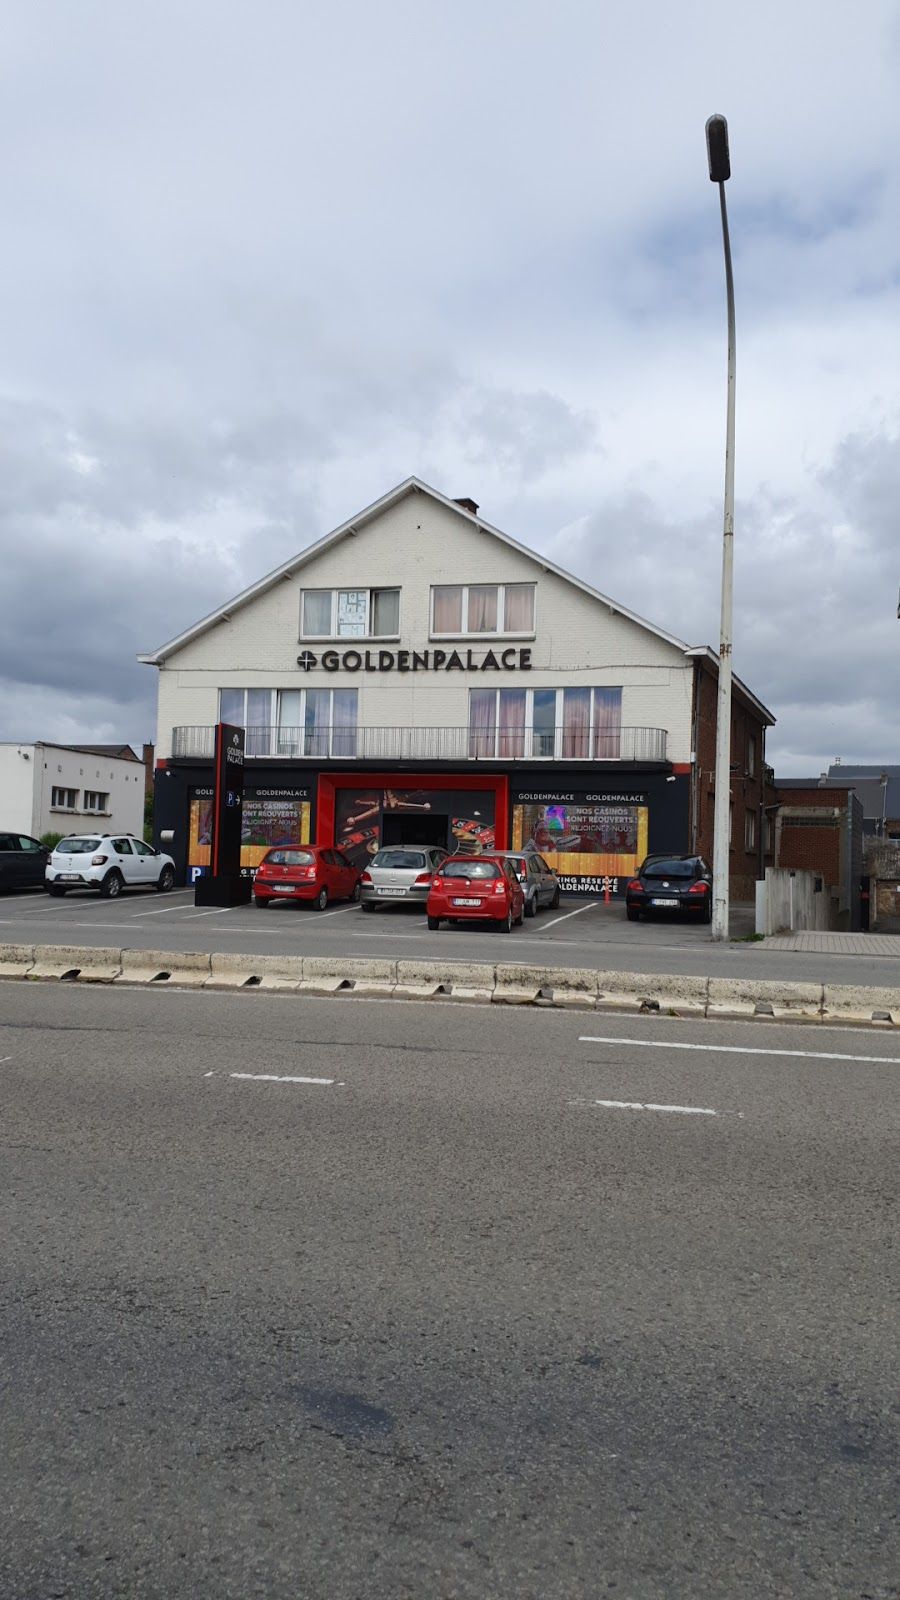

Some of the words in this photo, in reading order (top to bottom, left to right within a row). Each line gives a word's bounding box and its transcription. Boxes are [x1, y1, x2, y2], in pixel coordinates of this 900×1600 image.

[321, 648, 532, 672] GOLDENPALACE
[226, 746, 244, 756] GOLDEN
[226, 754, 244, 766] PALACE
[255, 789, 308, 797] GOLDENPALACE
[518, 793, 575, 801] GOLDENPALACE
[586, 794, 644, 802] GOLDENPALACE
[593, 808, 628, 816] CASINOS
[566, 815, 588, 823] SONT
[191, 866, 202, 883] P
